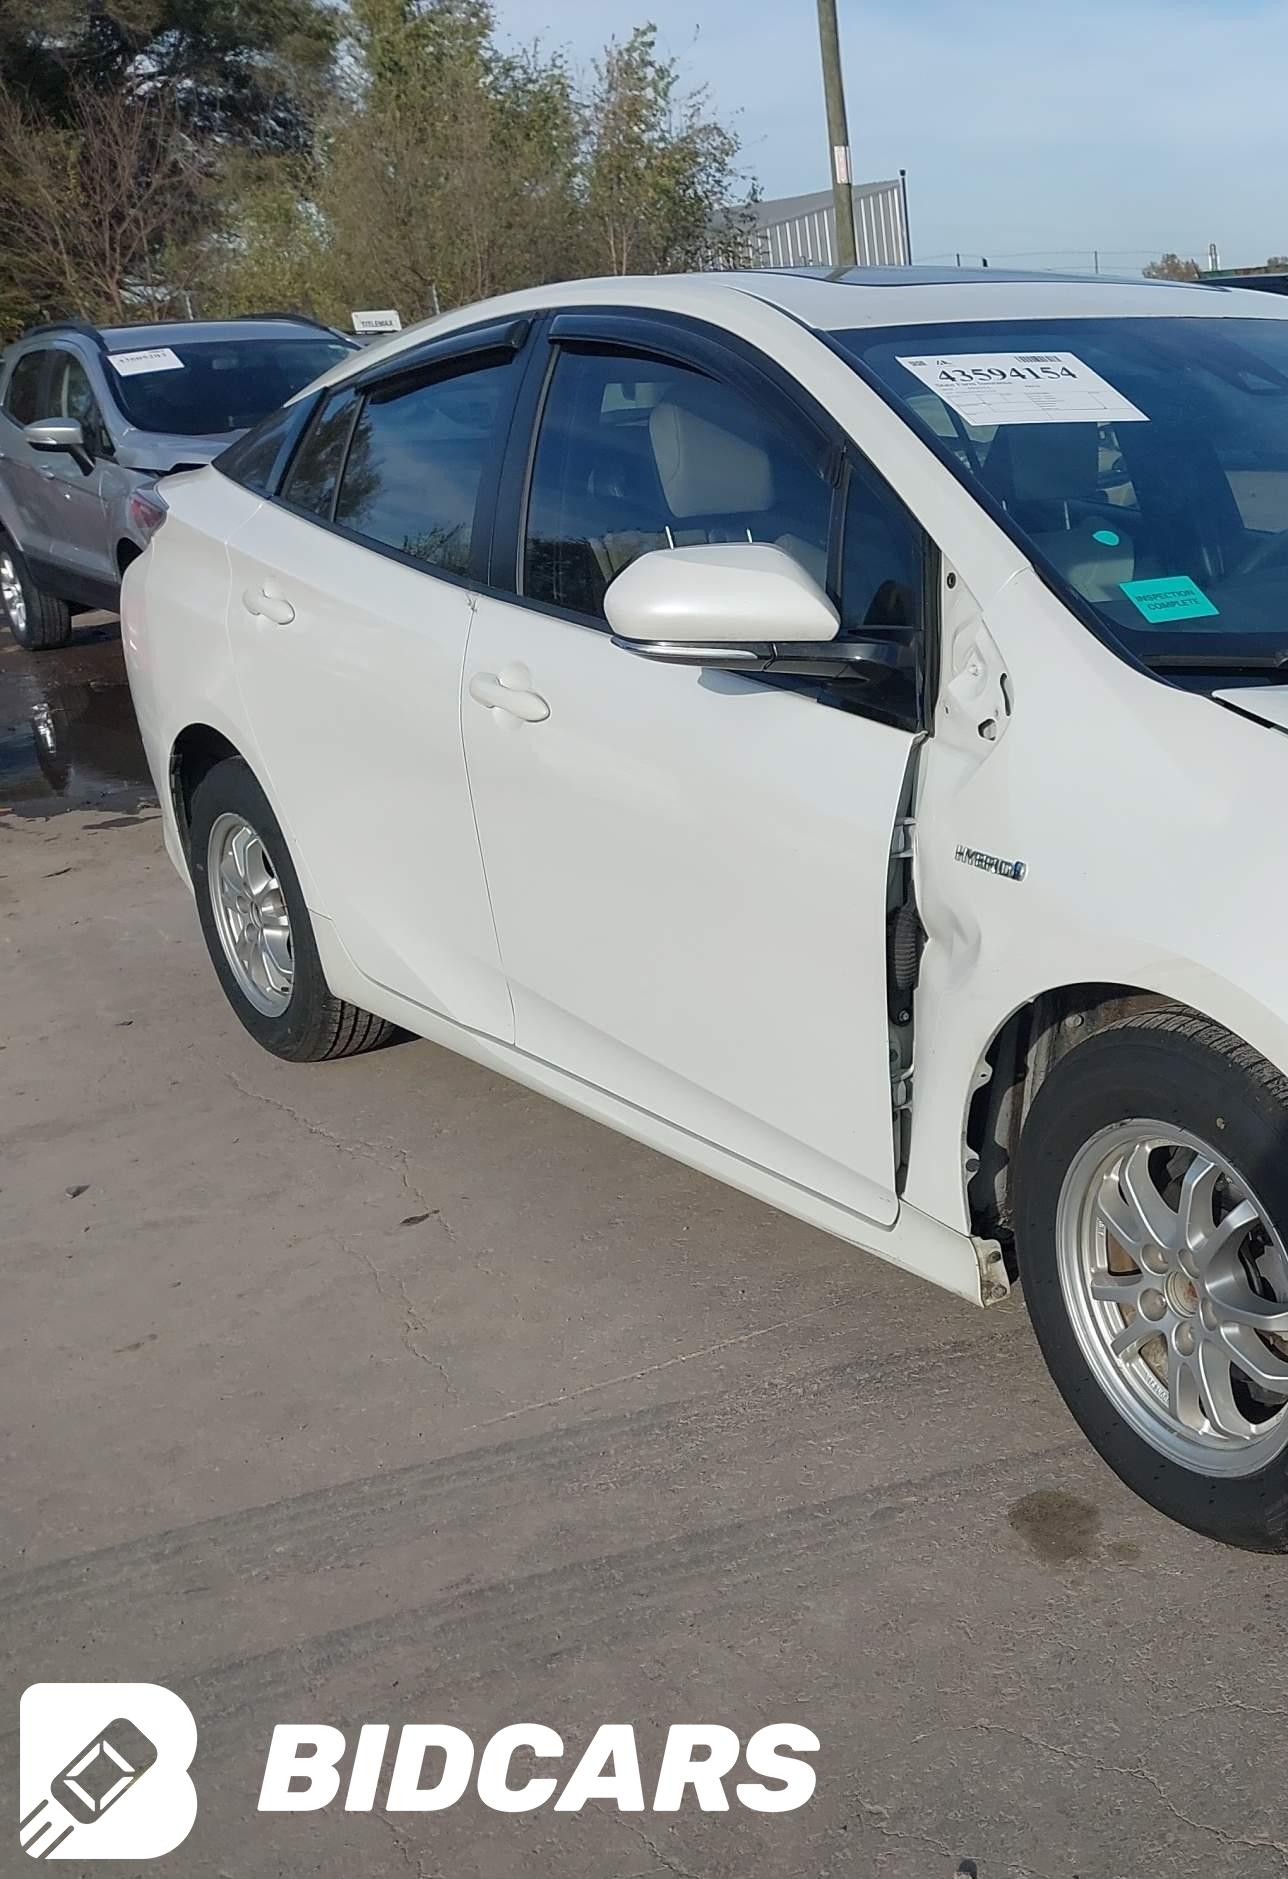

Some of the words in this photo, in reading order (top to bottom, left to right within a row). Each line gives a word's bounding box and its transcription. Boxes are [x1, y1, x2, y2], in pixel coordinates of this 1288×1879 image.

[938, 366, 1077, 382] 43594154
[1135, 589, 1195, 602] INSPECTION
[1147, 598, 1200, 611] COMPLETE
